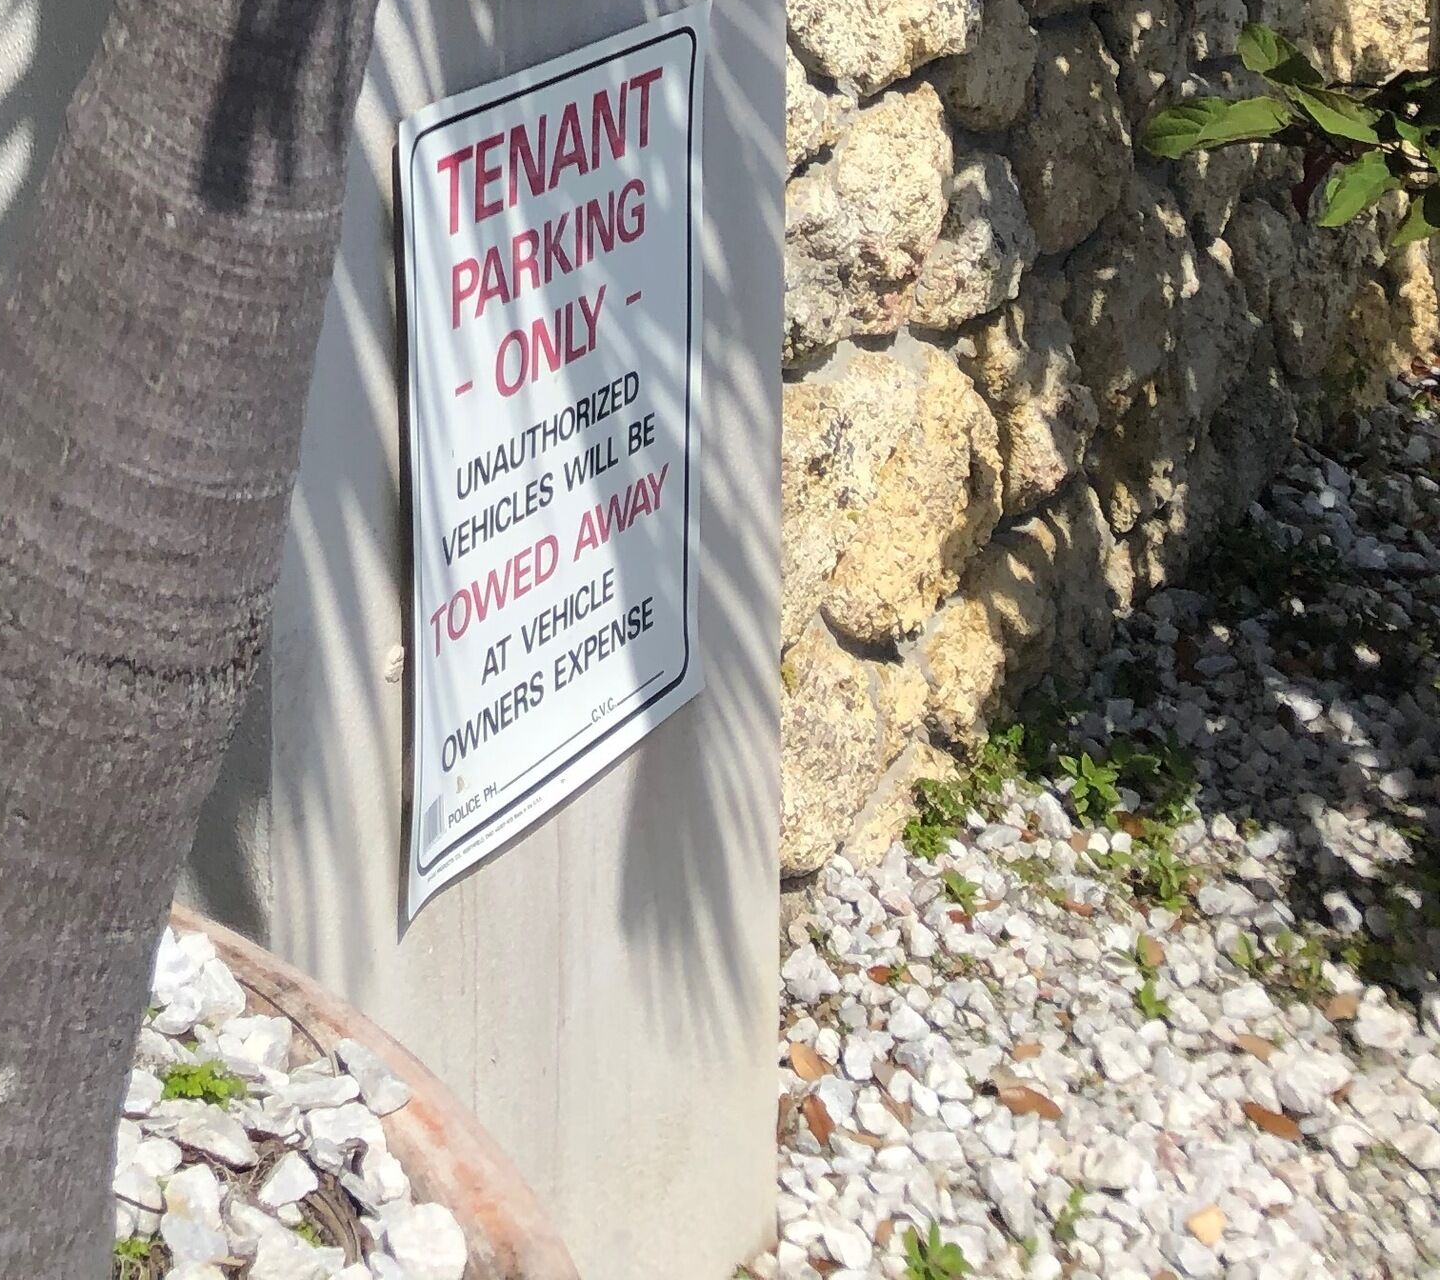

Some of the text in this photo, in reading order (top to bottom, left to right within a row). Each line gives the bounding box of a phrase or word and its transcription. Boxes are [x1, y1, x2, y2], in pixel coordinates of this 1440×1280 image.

[437, 67, 663, 235] TENANT
[452, 178, 646, 330] PARKING
[495, 284, 607, 398] ONLY
[442, 412, 655, 566] VEHICLES WILL BE
[457, 371, 639, 500] UNAUTHORIZED
[430, 462, 669, 658] TOWED AWAY
[481, 568, 615, 686] AT VEHICLE
[442, 596, 654, 773] OWNERS EXPENSE
[448, 794, 482, 829] POLICE
